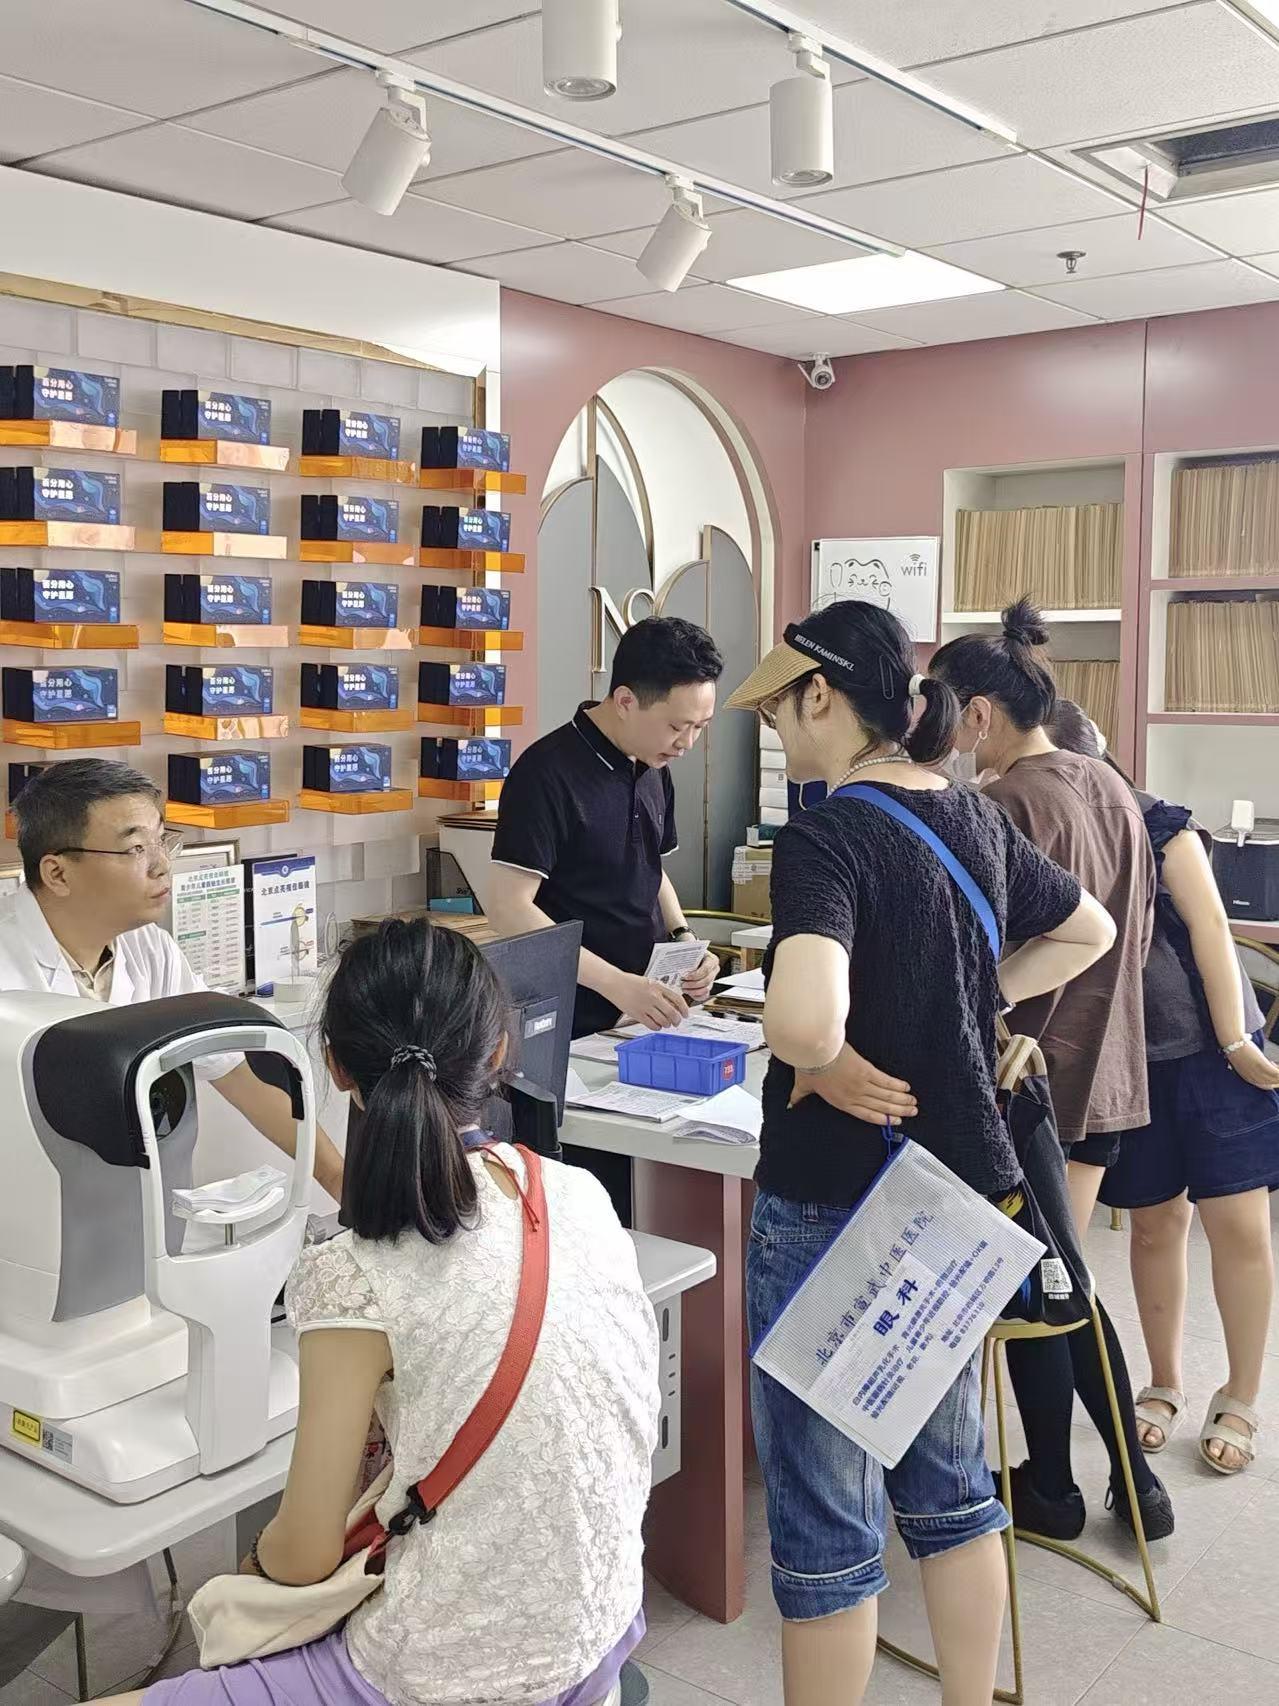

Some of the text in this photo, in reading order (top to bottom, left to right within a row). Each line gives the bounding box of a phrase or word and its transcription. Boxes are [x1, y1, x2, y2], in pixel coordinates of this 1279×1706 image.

[900, 562, 927, 577] wifi
[813, 645, 855, 671] KAMINSKI
[816, 1211, 932, 1368] 北京市宣武中医医院
[873, 1279, 918, 1336] 眼科
[853, 1345, 900, 1406] 白内障超声乳化手术
